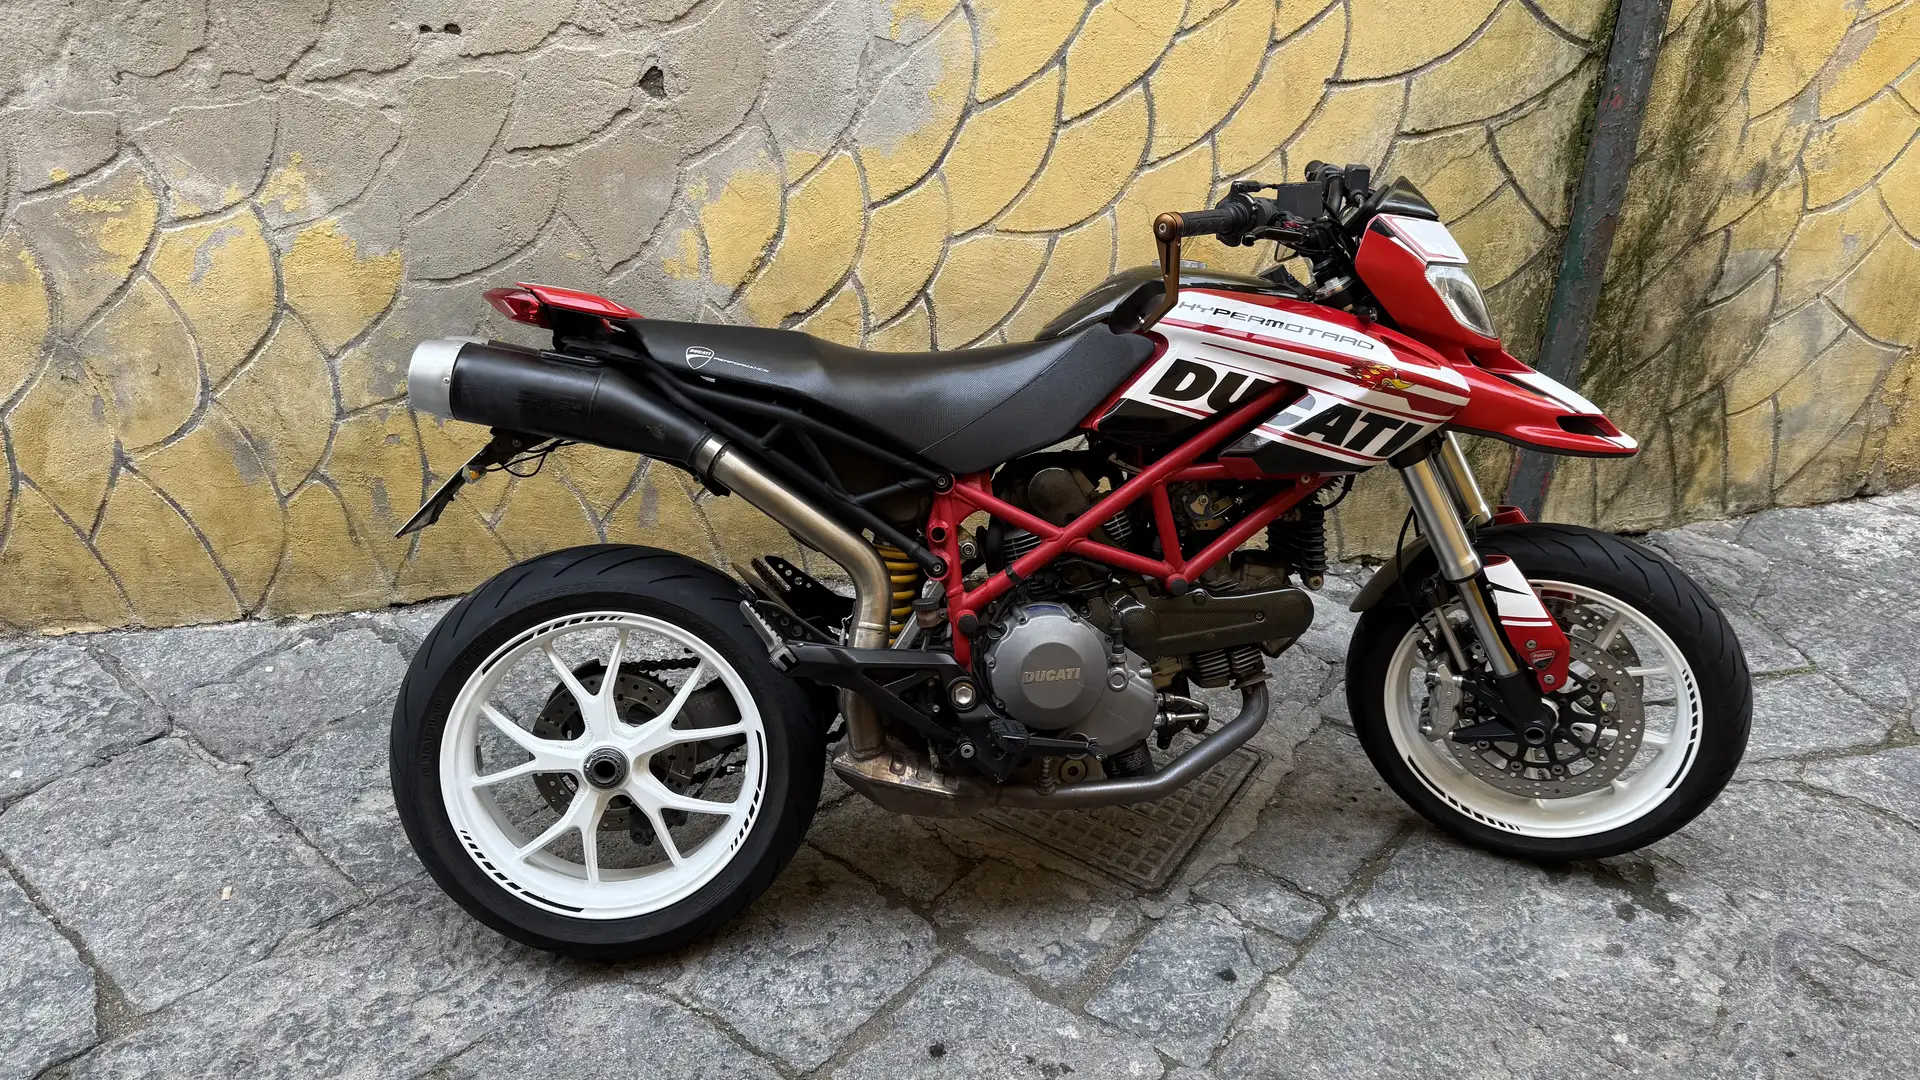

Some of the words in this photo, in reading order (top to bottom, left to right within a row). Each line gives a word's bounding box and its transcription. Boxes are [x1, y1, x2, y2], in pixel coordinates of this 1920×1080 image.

[1178, 301, 1375, 350] HYPERMOTARD
[689, 348, 712, 356] DUCATI
[1022, 667, 1081, 685] DUCATI
